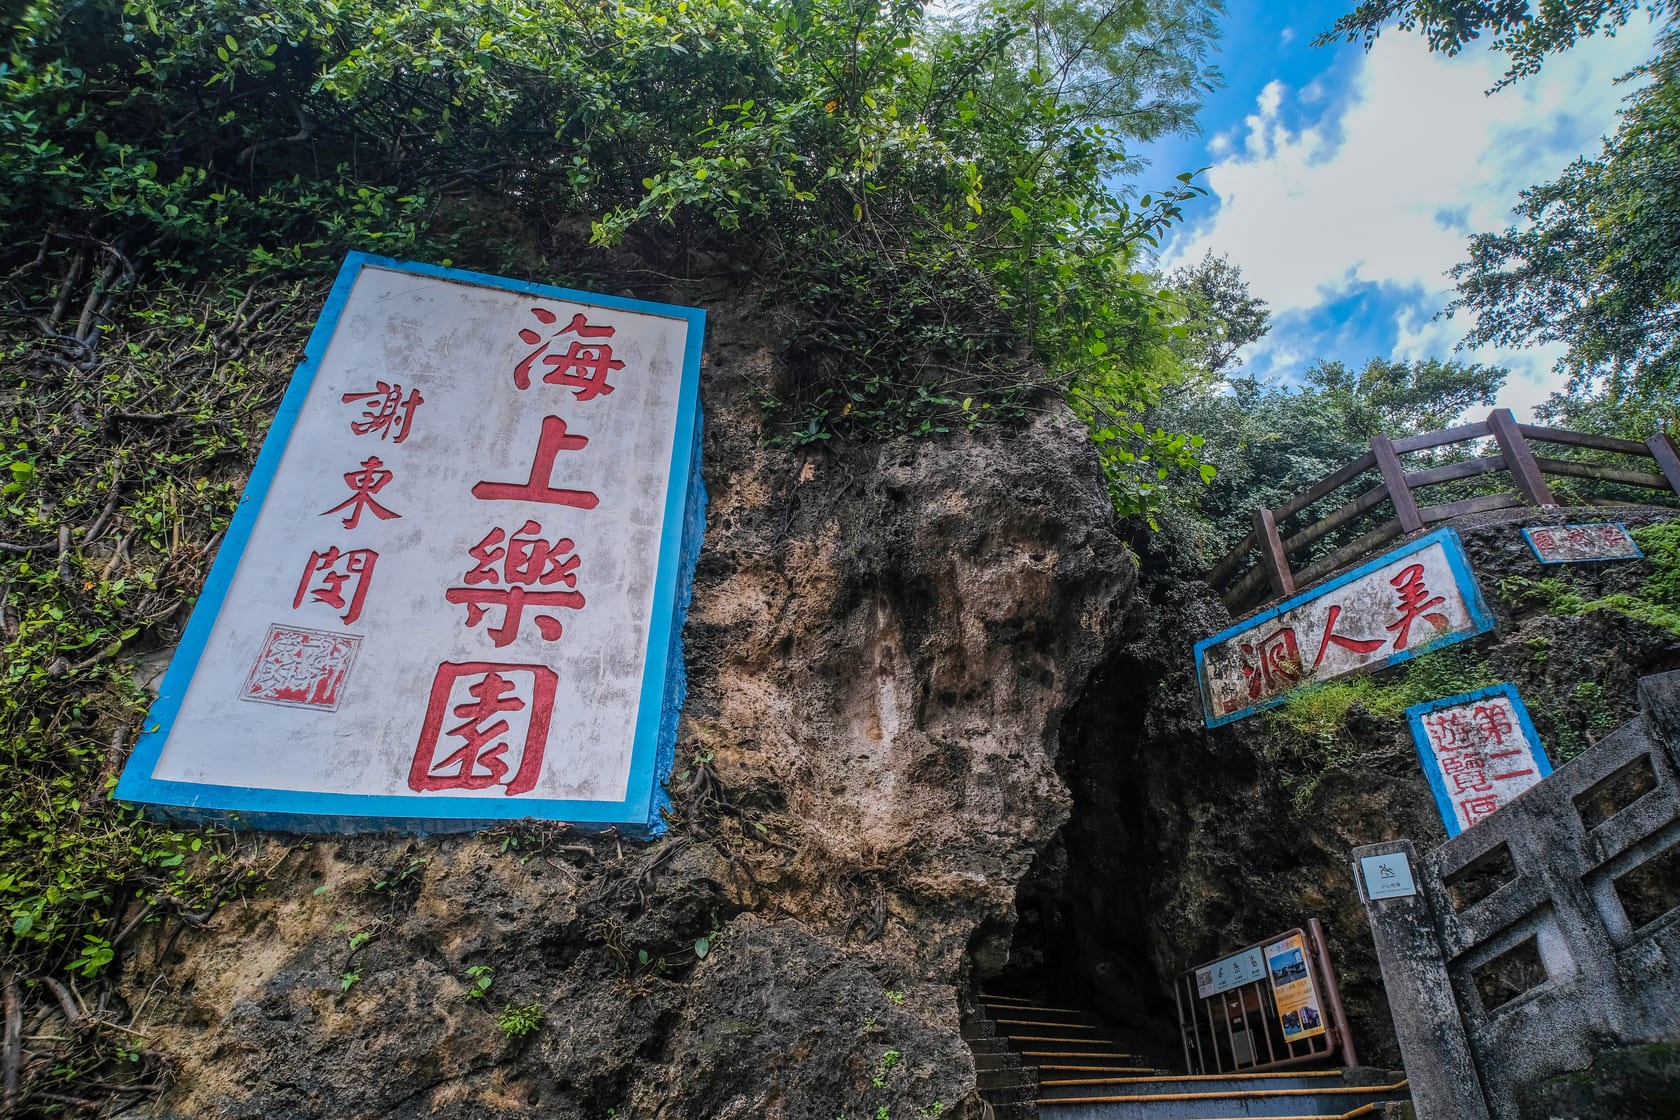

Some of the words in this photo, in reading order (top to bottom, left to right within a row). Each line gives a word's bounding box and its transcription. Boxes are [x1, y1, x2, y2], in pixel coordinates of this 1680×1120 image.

[409, 307, 626, 796] 海上樂園
[1240, 564, 1449, 698] 美人洞
[1473, 704, 1534, 781] 第二
